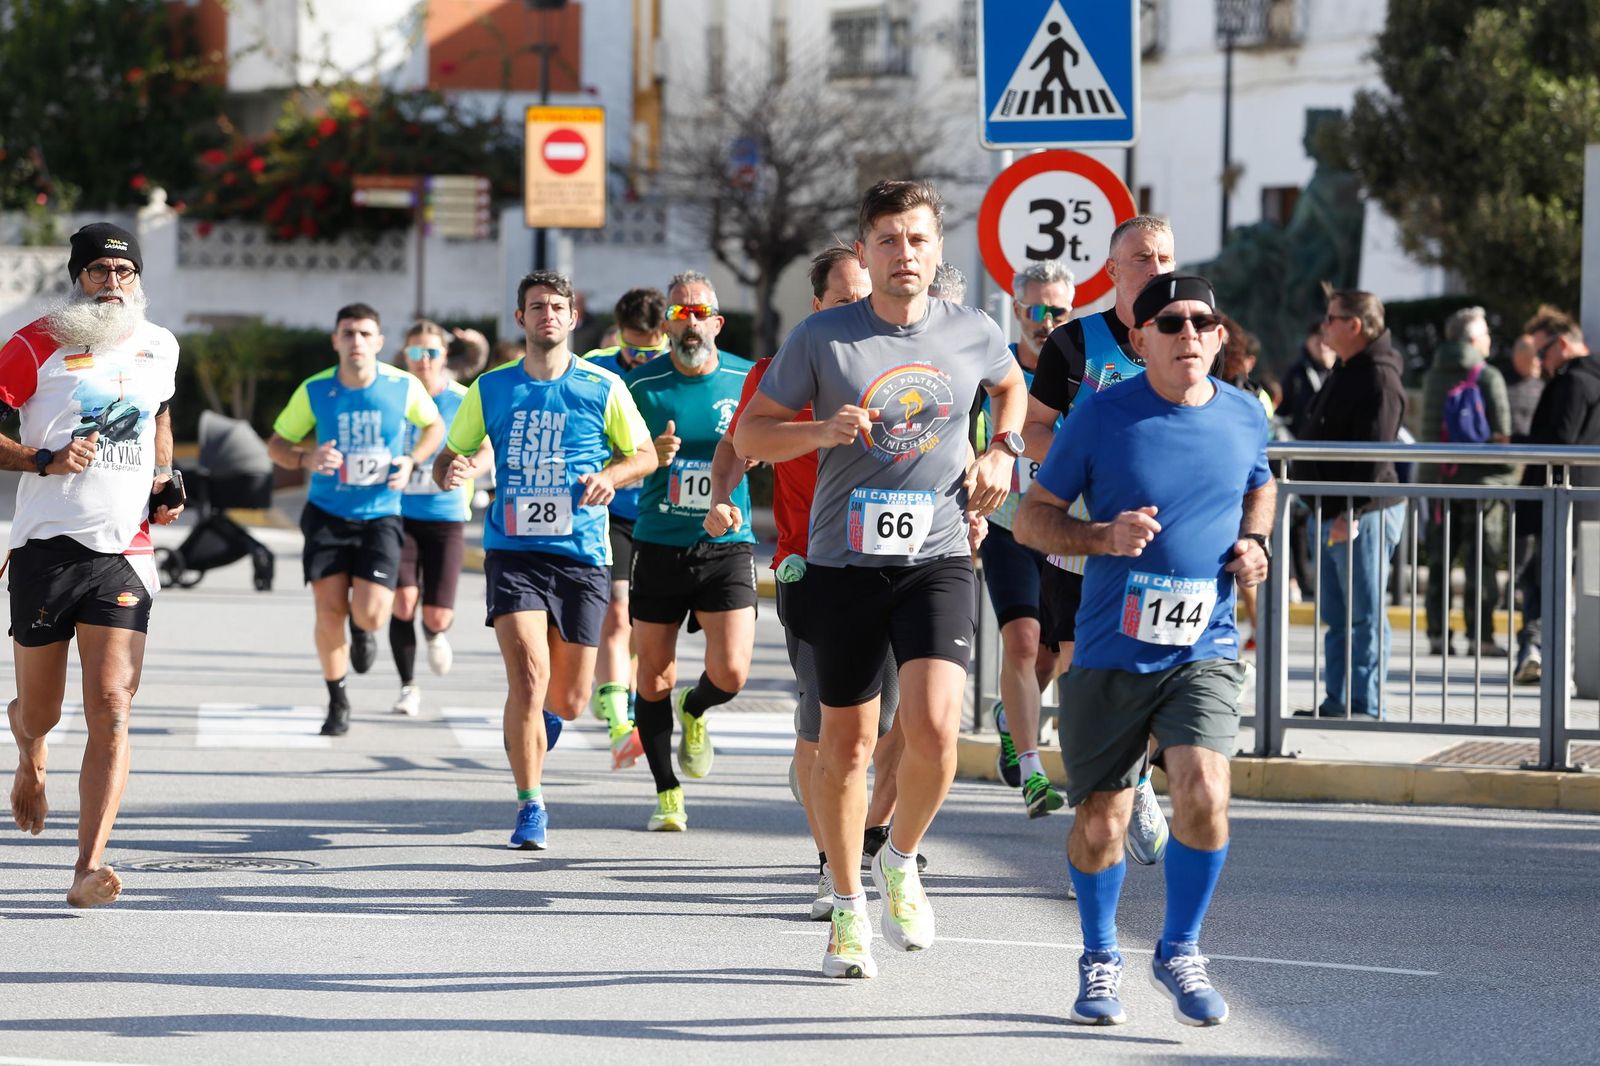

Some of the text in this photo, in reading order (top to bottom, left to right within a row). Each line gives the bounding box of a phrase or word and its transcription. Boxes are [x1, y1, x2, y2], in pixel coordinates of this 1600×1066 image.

[528, 410, 566, 431] SAN
[506, 410, 528, 470] CARRERA
[357, 459, 378, 475] 12
[520, 487, 570, 495] CARRERA
[870, 491, 932, 502] CARRERA
[527, 502, 557, 523] 28
[877, 511, 914, 539] 66
[1133, 573, 1215, 591] III CARRERA
[1148, 598, 1203, 628] 144
